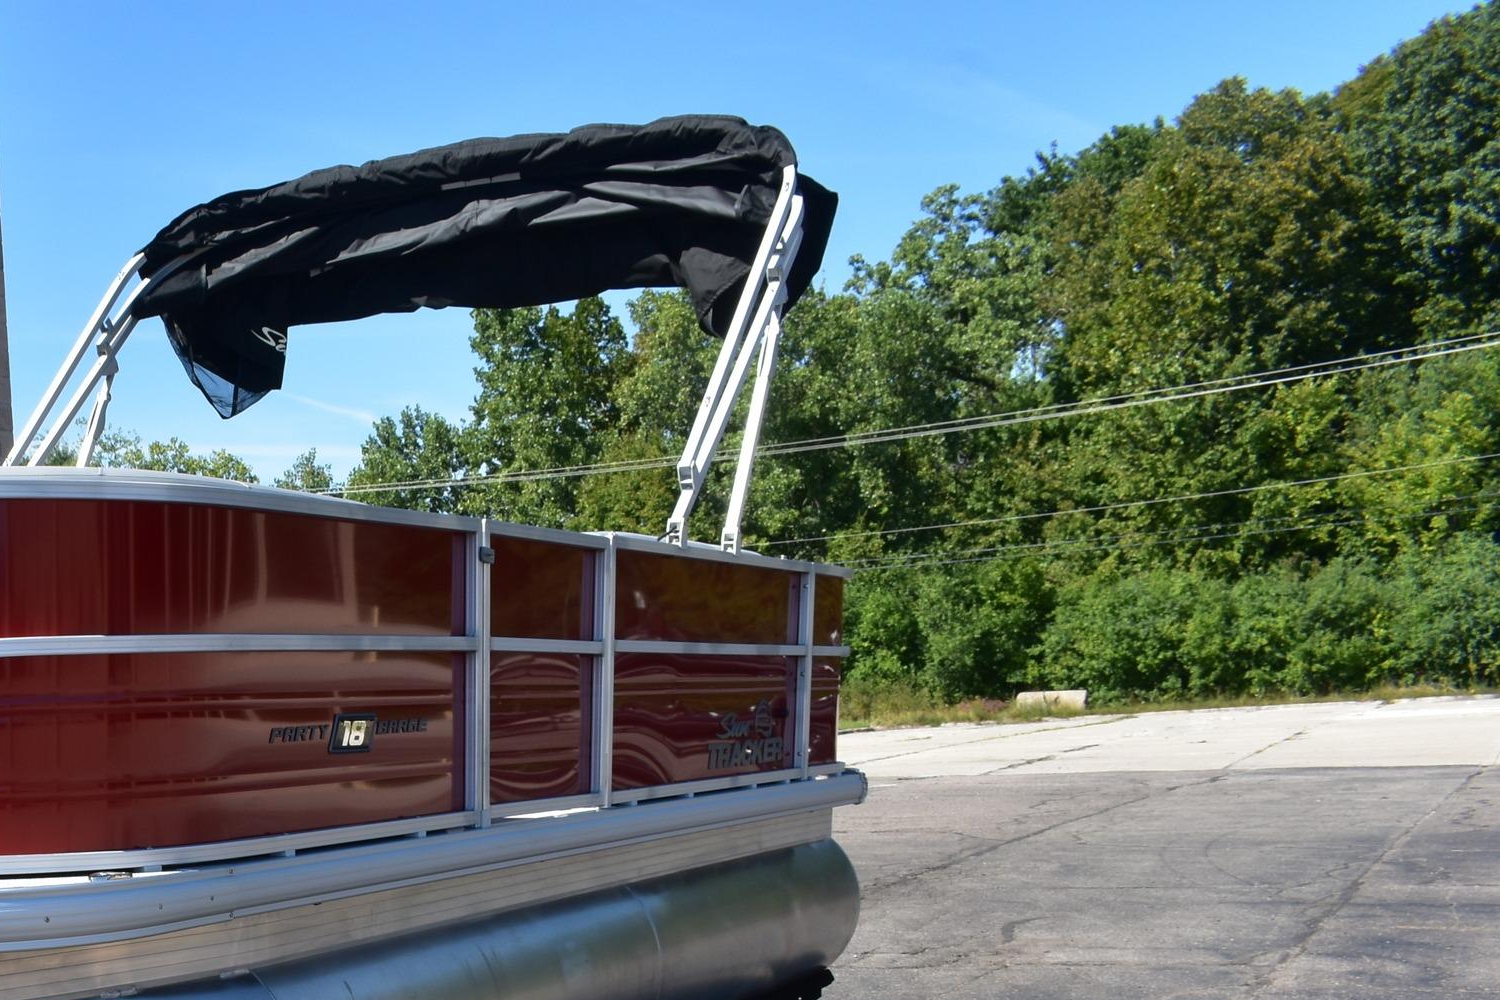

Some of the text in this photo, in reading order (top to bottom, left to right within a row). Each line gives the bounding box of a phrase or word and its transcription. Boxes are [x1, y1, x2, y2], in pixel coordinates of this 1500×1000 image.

[268, 717, 429, 747] PARTY 18 BARGE
[716, 712, 750, 739] Sun
[707, 736, 784, 770] TRACKER
